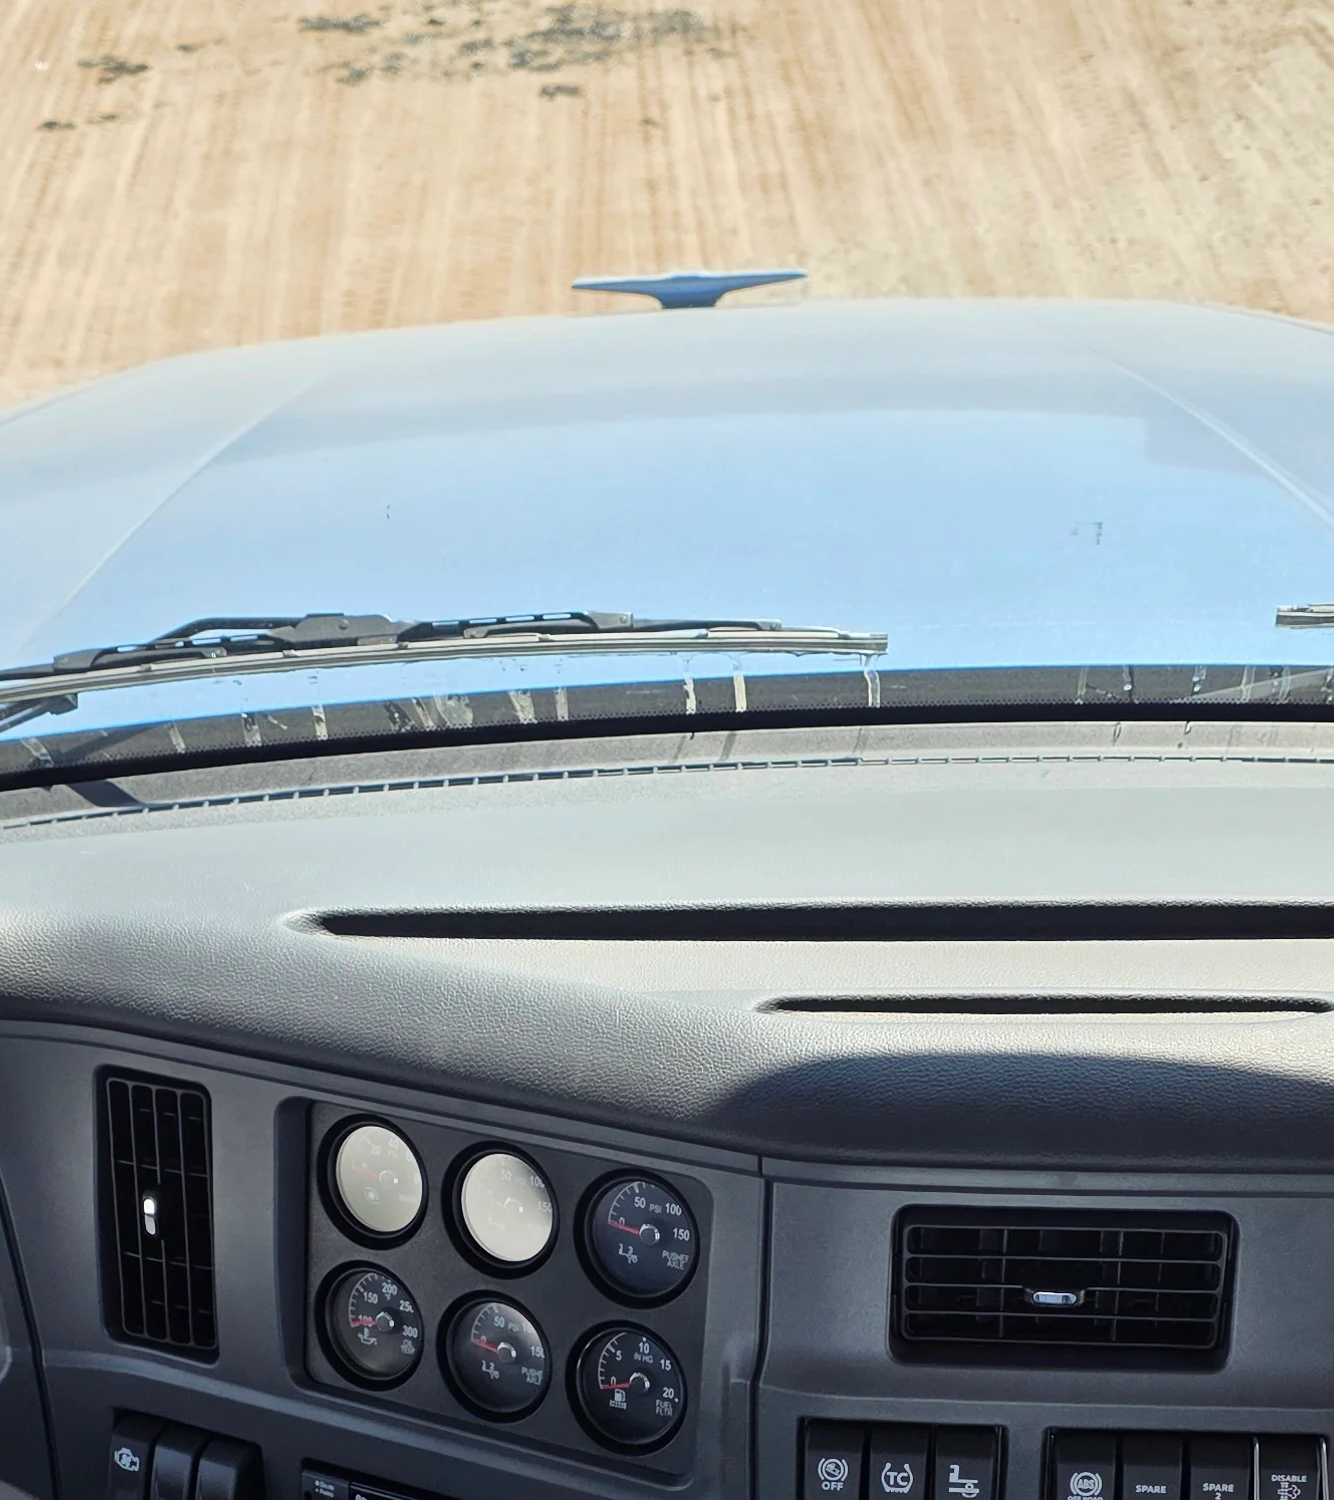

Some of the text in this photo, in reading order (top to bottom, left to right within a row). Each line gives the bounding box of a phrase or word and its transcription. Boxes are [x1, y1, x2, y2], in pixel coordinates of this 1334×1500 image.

[634, 1197, 682, 1216] 50 PSI 100
[673, 1227, 690, 1241] 150
[381, 1282, 397, 1295] 200
[363, 1291, 378, 1304] 150
[493, 1316, 505, 1328] 50
[402, 1325, 418, 1338] 300
[639, 1342, 649, 1354] 10
[615, 1350, 622, 1361] 5
[642, 1356, 653, 1364] HG
[660, 1359, 671, 1371] 15
[662, 1387, 674, 1399] 20
[887, 1471, 909, 1486] TC
[1077, 1478, 1095, 1490] ABS
[1271, 1474, 1307, 1483] DISABLE
[821, 1481, 844, 1491] OFF
[1135, 1484, 1167, 1494] SPARE
[1202, 1483, 1234, 1493] SPARE
